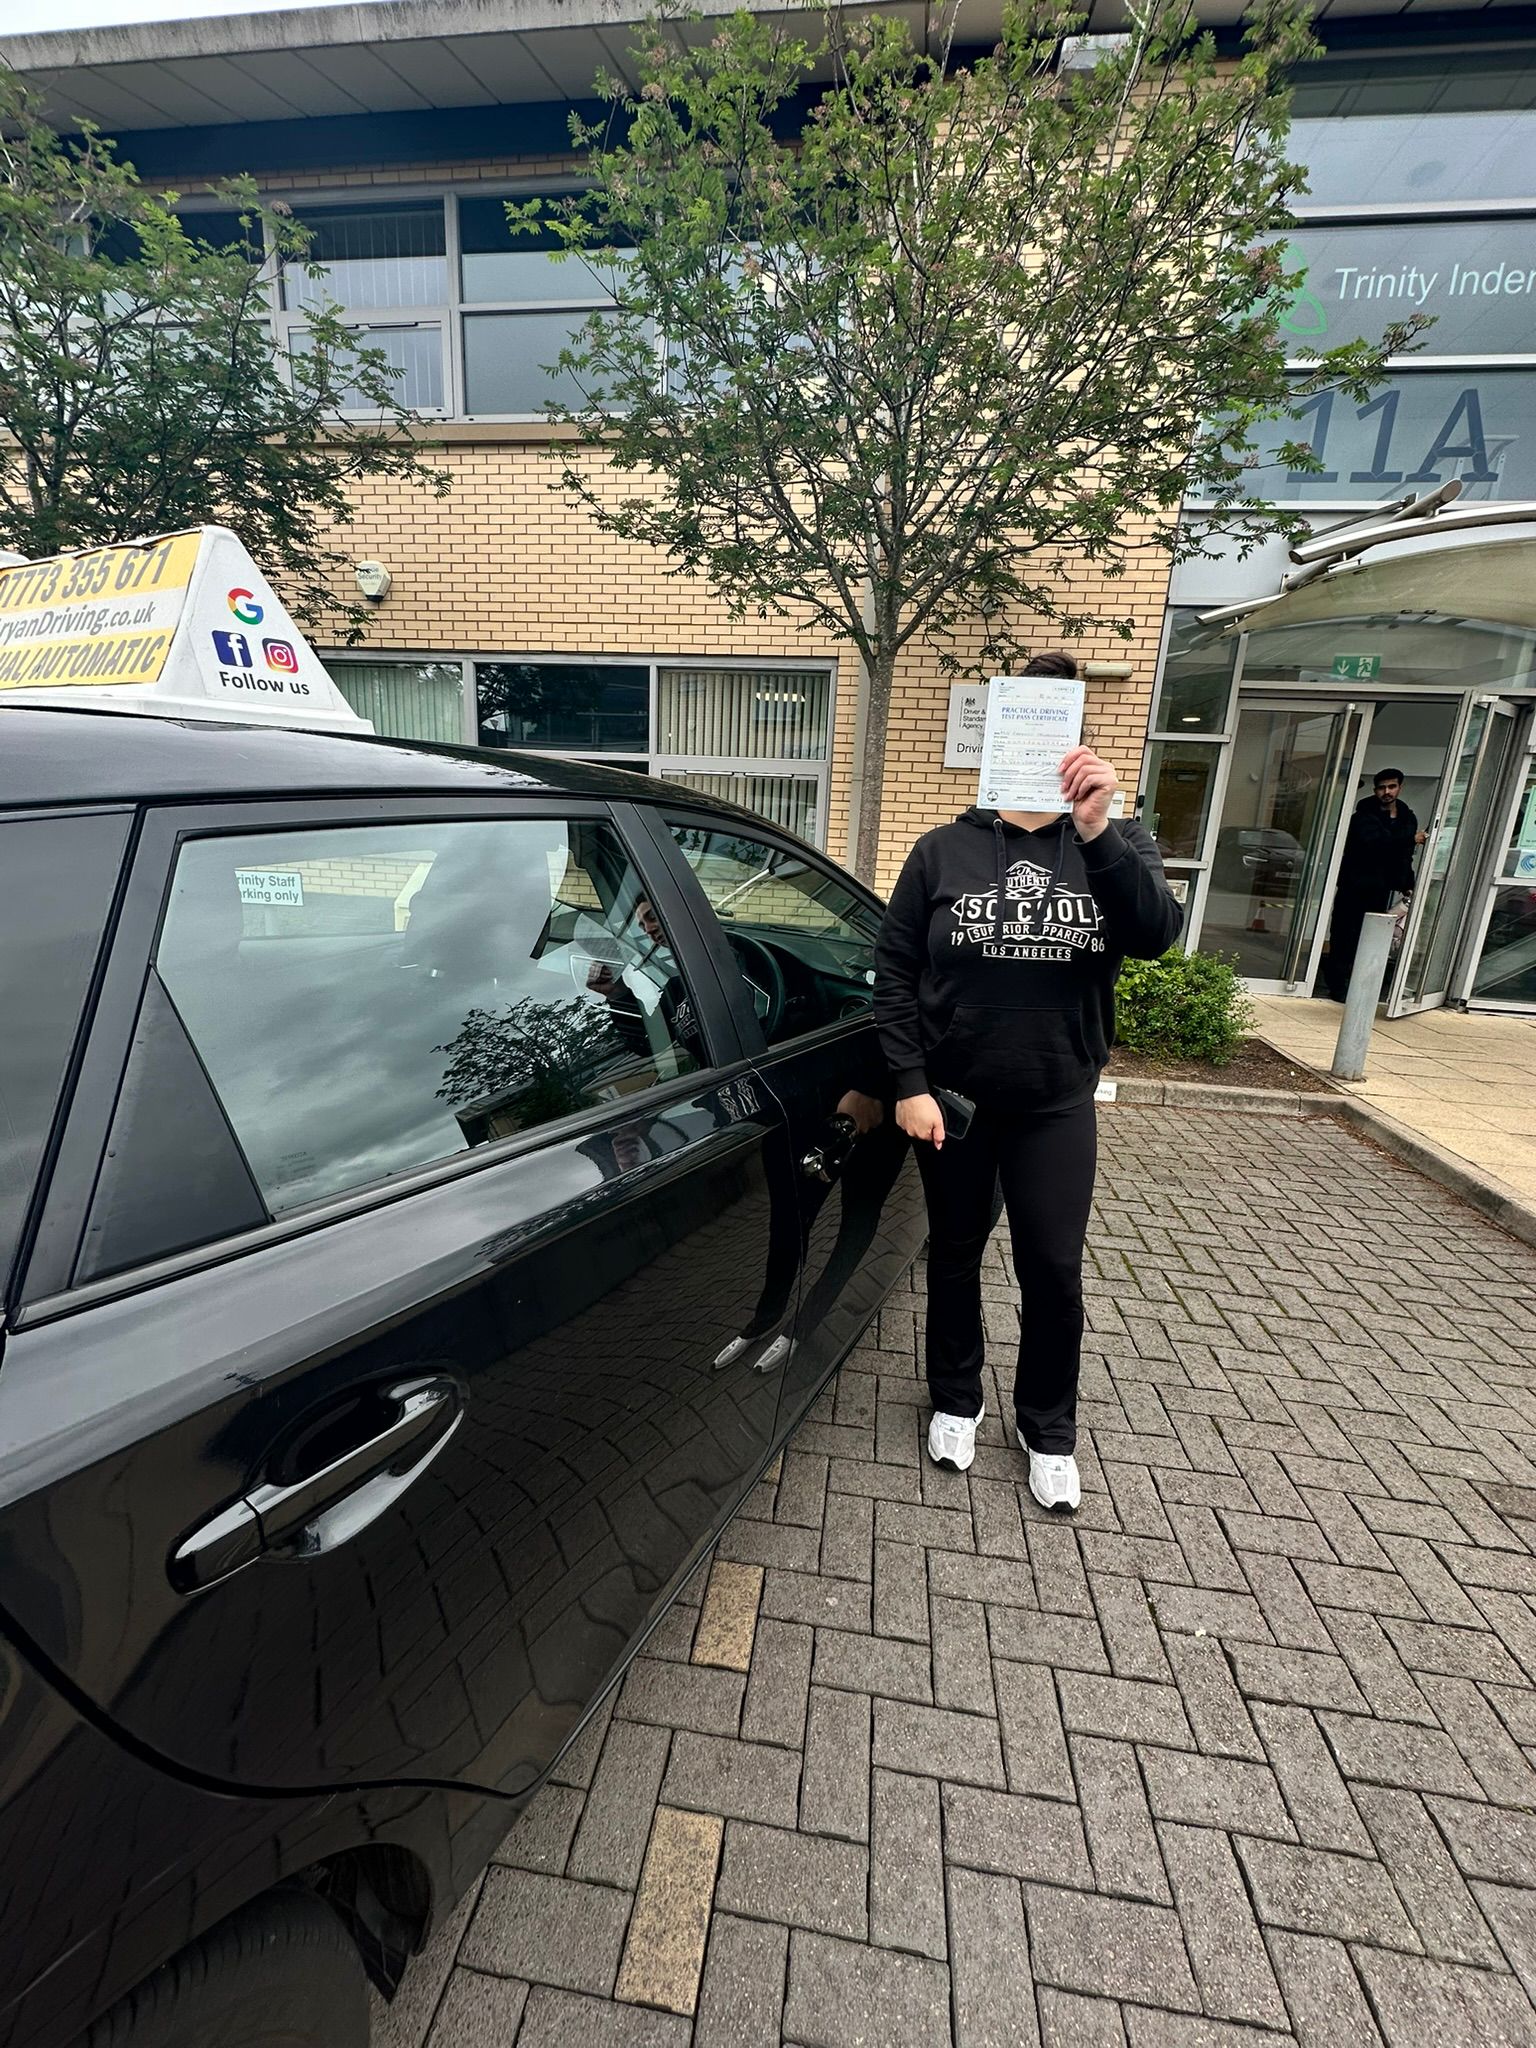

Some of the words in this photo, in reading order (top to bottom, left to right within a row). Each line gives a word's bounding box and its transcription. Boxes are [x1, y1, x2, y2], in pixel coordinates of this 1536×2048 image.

[1335, 265, 1438, 305] Trinity
[1286, 388, 1498, 483] 11A
[61, 553, 116, 599] 355
[115, 541, 174, 590] 671
[0, 601, 156, 646] ryanDriving.co.uk
[219, 671, 284, 693] Follow
[290, 682, 310, 696] us
[1001, 706, 1037, 714] PRACTICAL
[1039, 708, 1069, 716] DRIVING
[1032, 714, 1068, 722] CERTIFICATE
[962, 722, 983, 730] Agency
[1016, 865, 1038, 876] The
[268, 875, 295, 887] Staff
[1007, 876, 1050, 888] UTHENTI
[242, 888, 271, 902] rking
[274, 890, 299, 904] only
[951, 931, 964, 946] 19
[972, 924, 1030, 939] SUPRIOR
[1042, 925, 1084, 945] PPAREL
[1091, 937, 1105, 952] 86
[983, 944, 1006, 956] LOS
[1013, 947, 1072, 959] ANGELES
